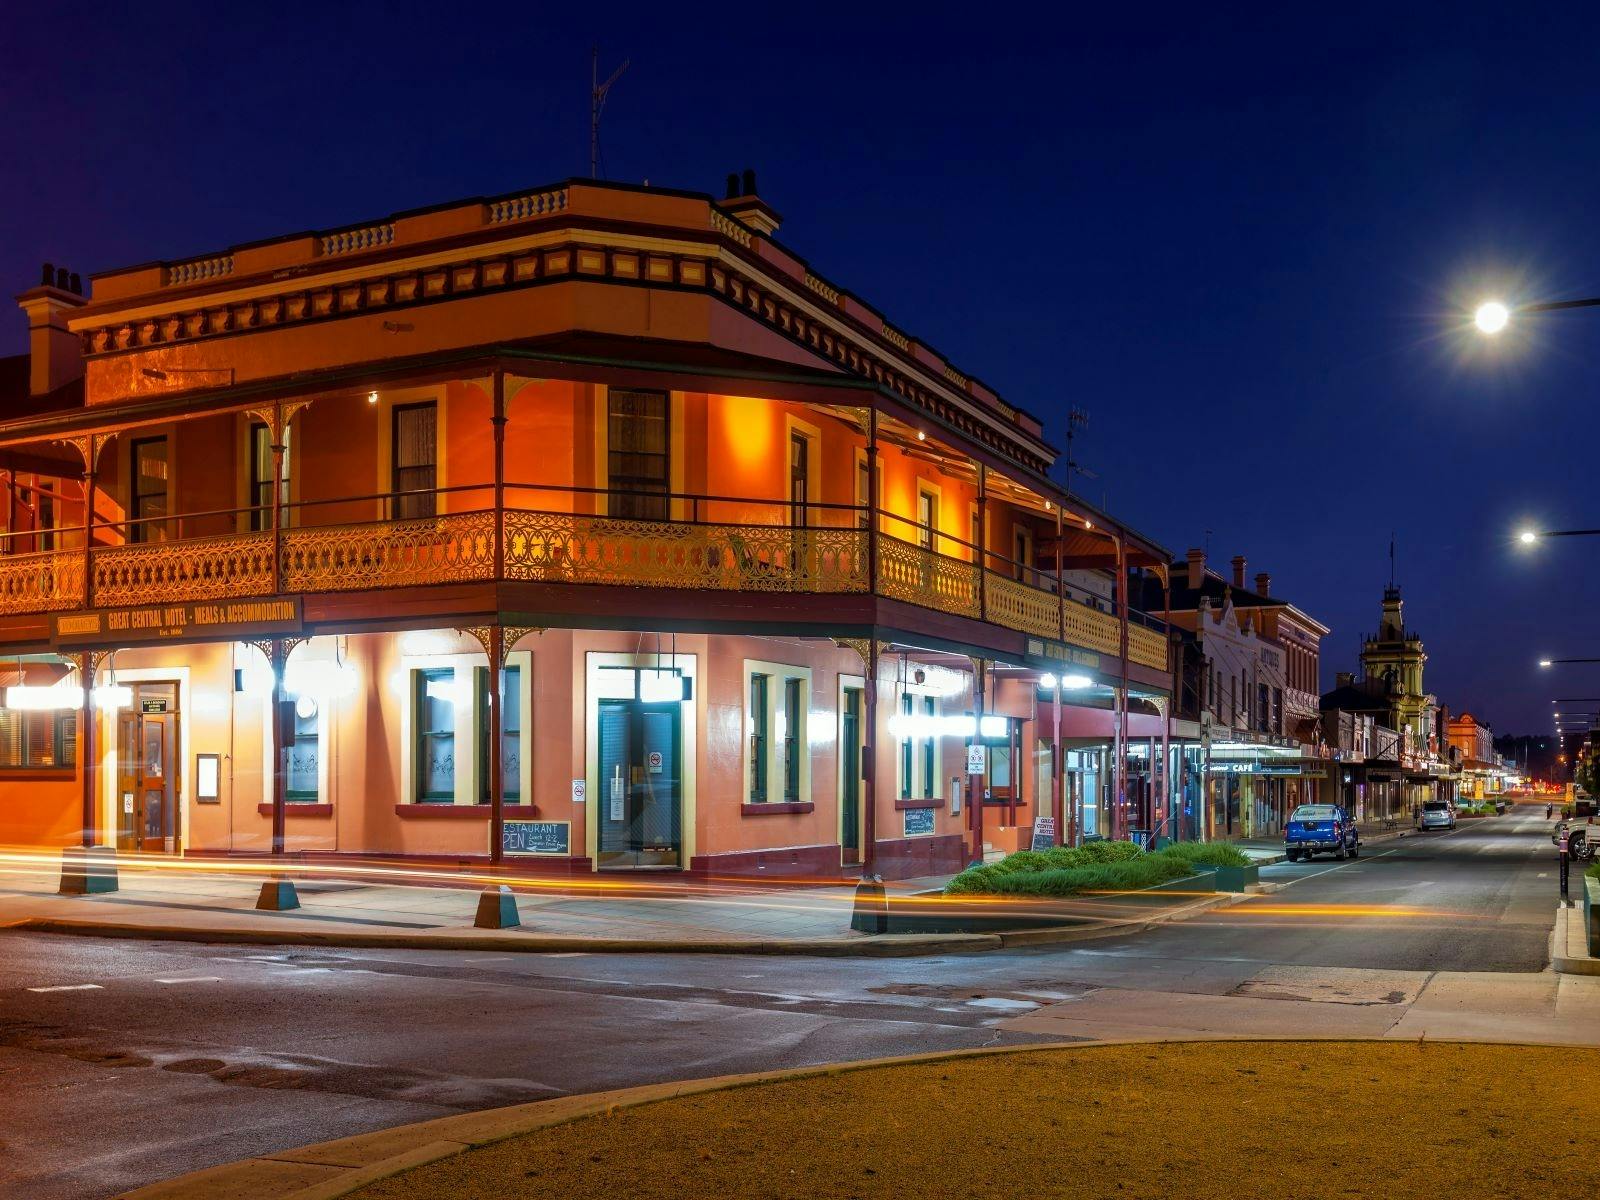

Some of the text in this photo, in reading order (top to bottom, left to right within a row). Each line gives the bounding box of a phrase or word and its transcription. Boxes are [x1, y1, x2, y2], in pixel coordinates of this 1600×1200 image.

[108, 612, 130, 630] GREAT
[131, 609, 163, 629] CENTRAL
[165, 607, 187, 626] HOTEL
[194, 605, 219, 625] MEALS
[219, 607, 226, 624] &
[227, 601, 295, 623] ACCOMMODATION
[504, 824, 558, 833] ESTAURANT
[503, 833, 524, 848] PEN
